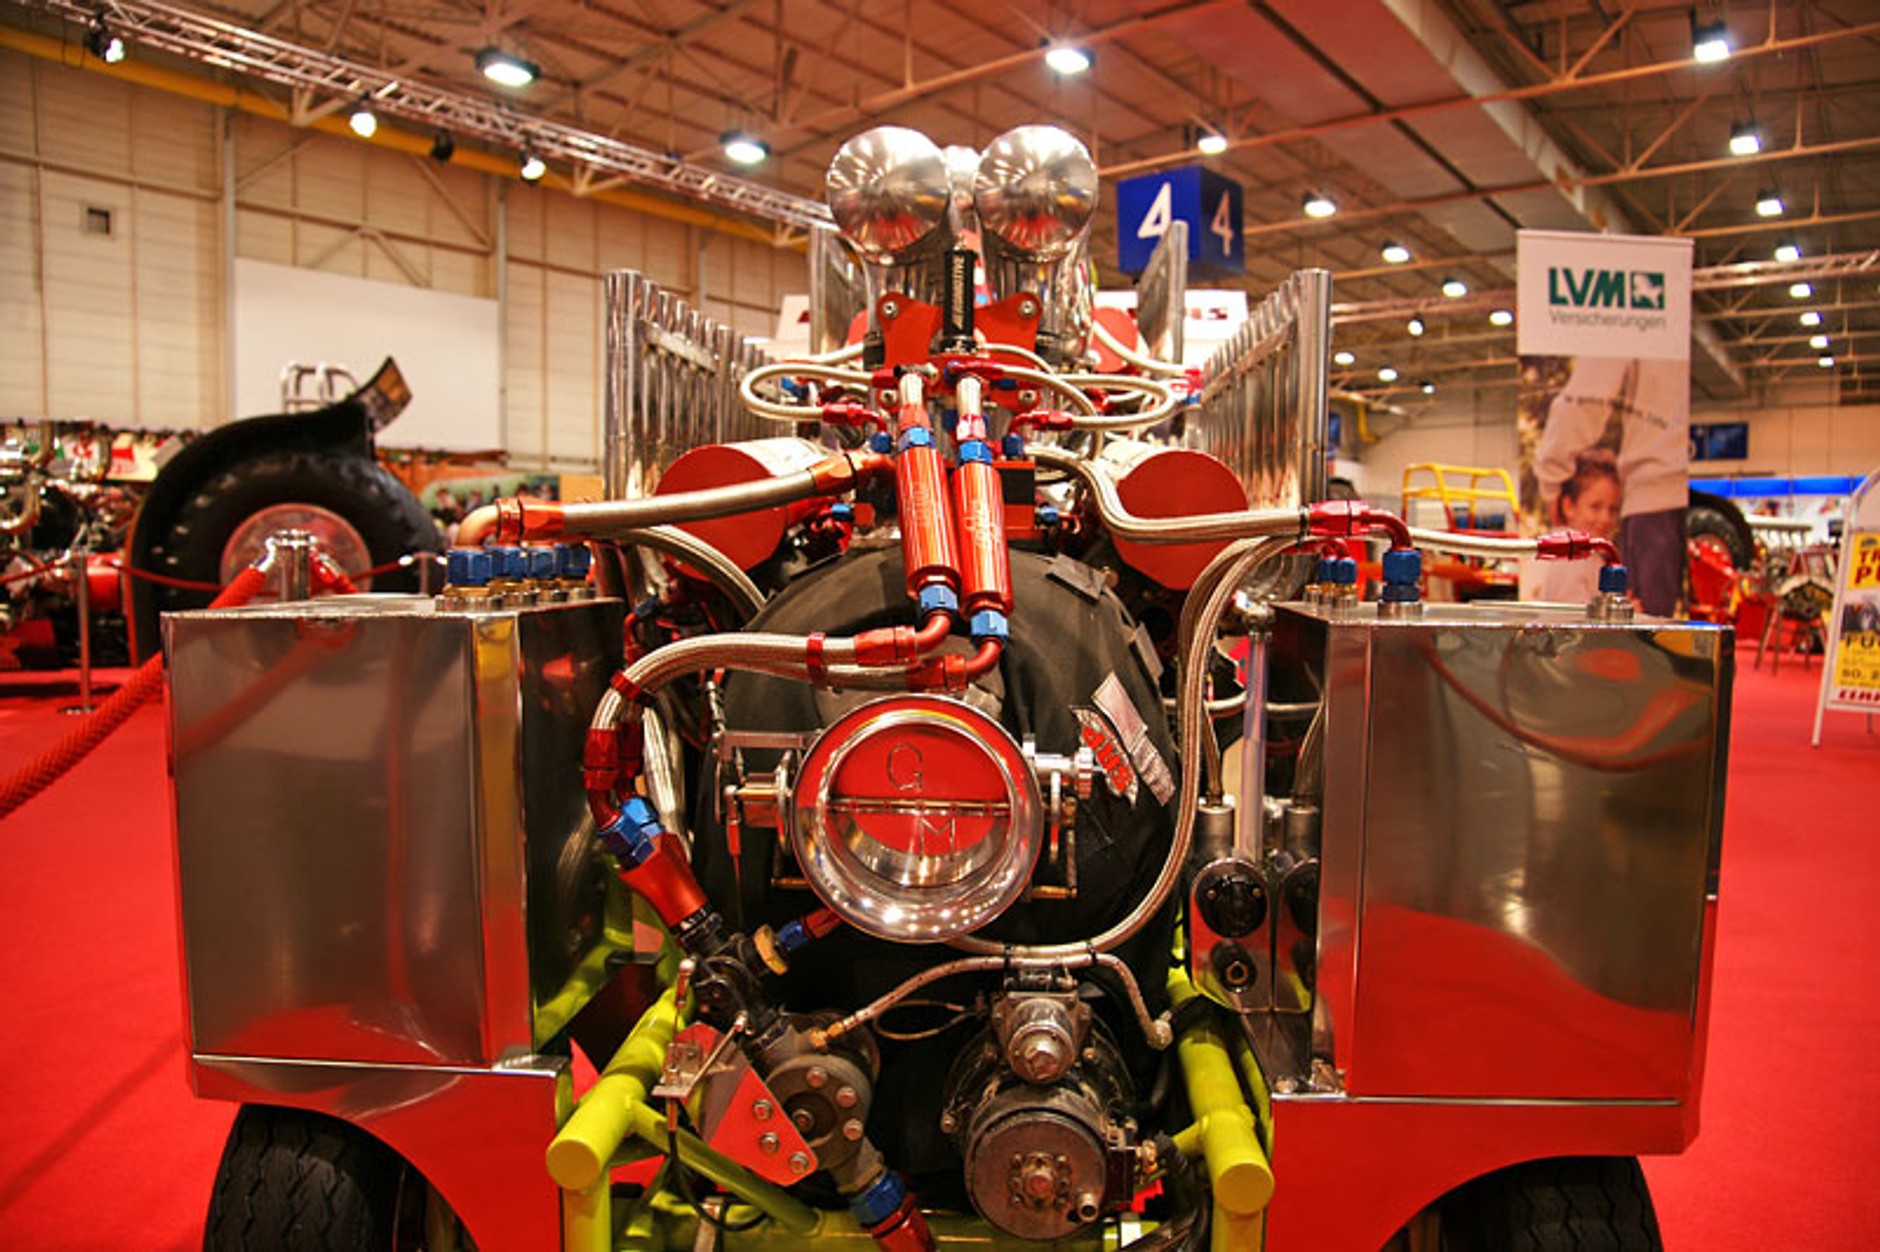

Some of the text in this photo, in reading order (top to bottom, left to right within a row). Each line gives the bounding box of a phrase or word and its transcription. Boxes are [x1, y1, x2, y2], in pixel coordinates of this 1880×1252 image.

[1137, 181, 1172, 239] 4
[1210, 189, 1234, 257] 4
[1549, 267, 1626, 308] LVM
[1550, 311, 1667, 332] Versicherungen
[1082, 725, 1133, 794] SRP
[918, 817, 956, 860] M
